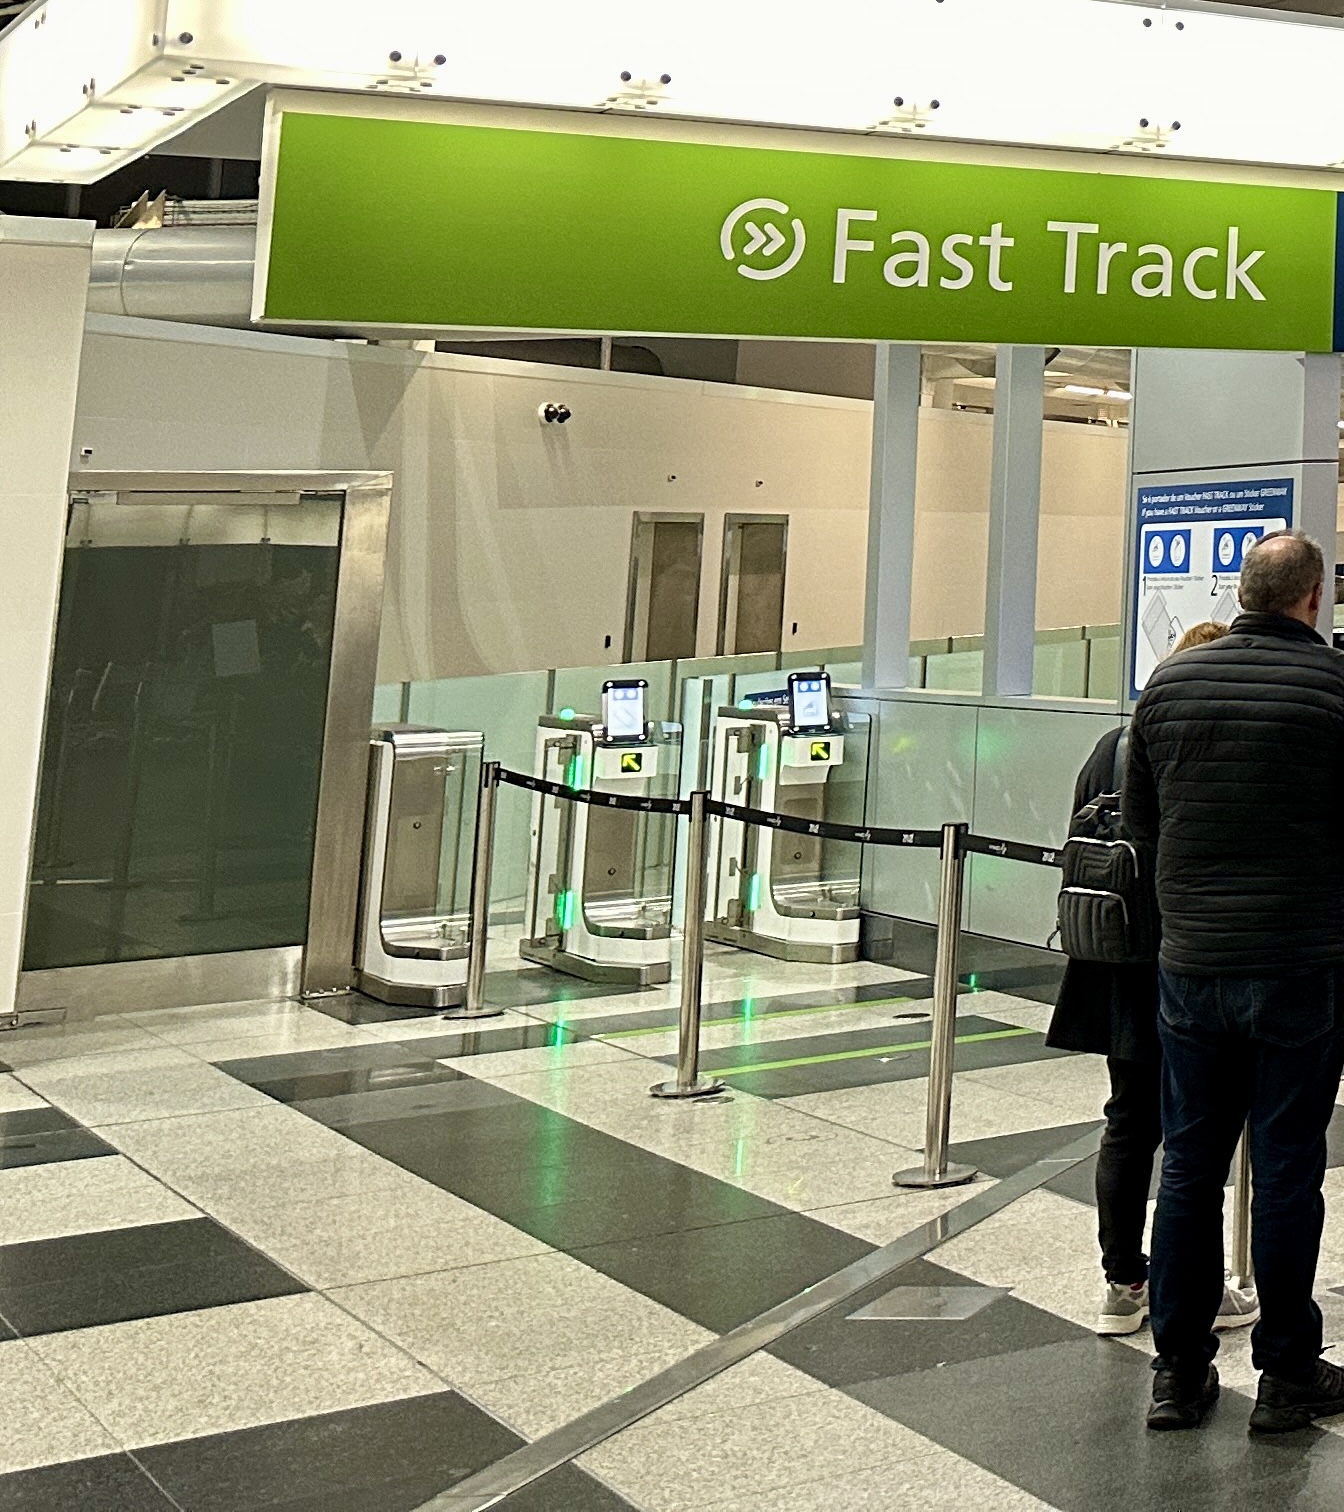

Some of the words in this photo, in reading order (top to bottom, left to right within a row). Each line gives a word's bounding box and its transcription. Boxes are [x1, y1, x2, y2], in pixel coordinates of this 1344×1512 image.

[832, 207, 1015, 292] Fast
[1046, 220, 1267, 301] Track
[1142, 576, 1147, 597] 1
[1211, 574, 1218, 597] 2
